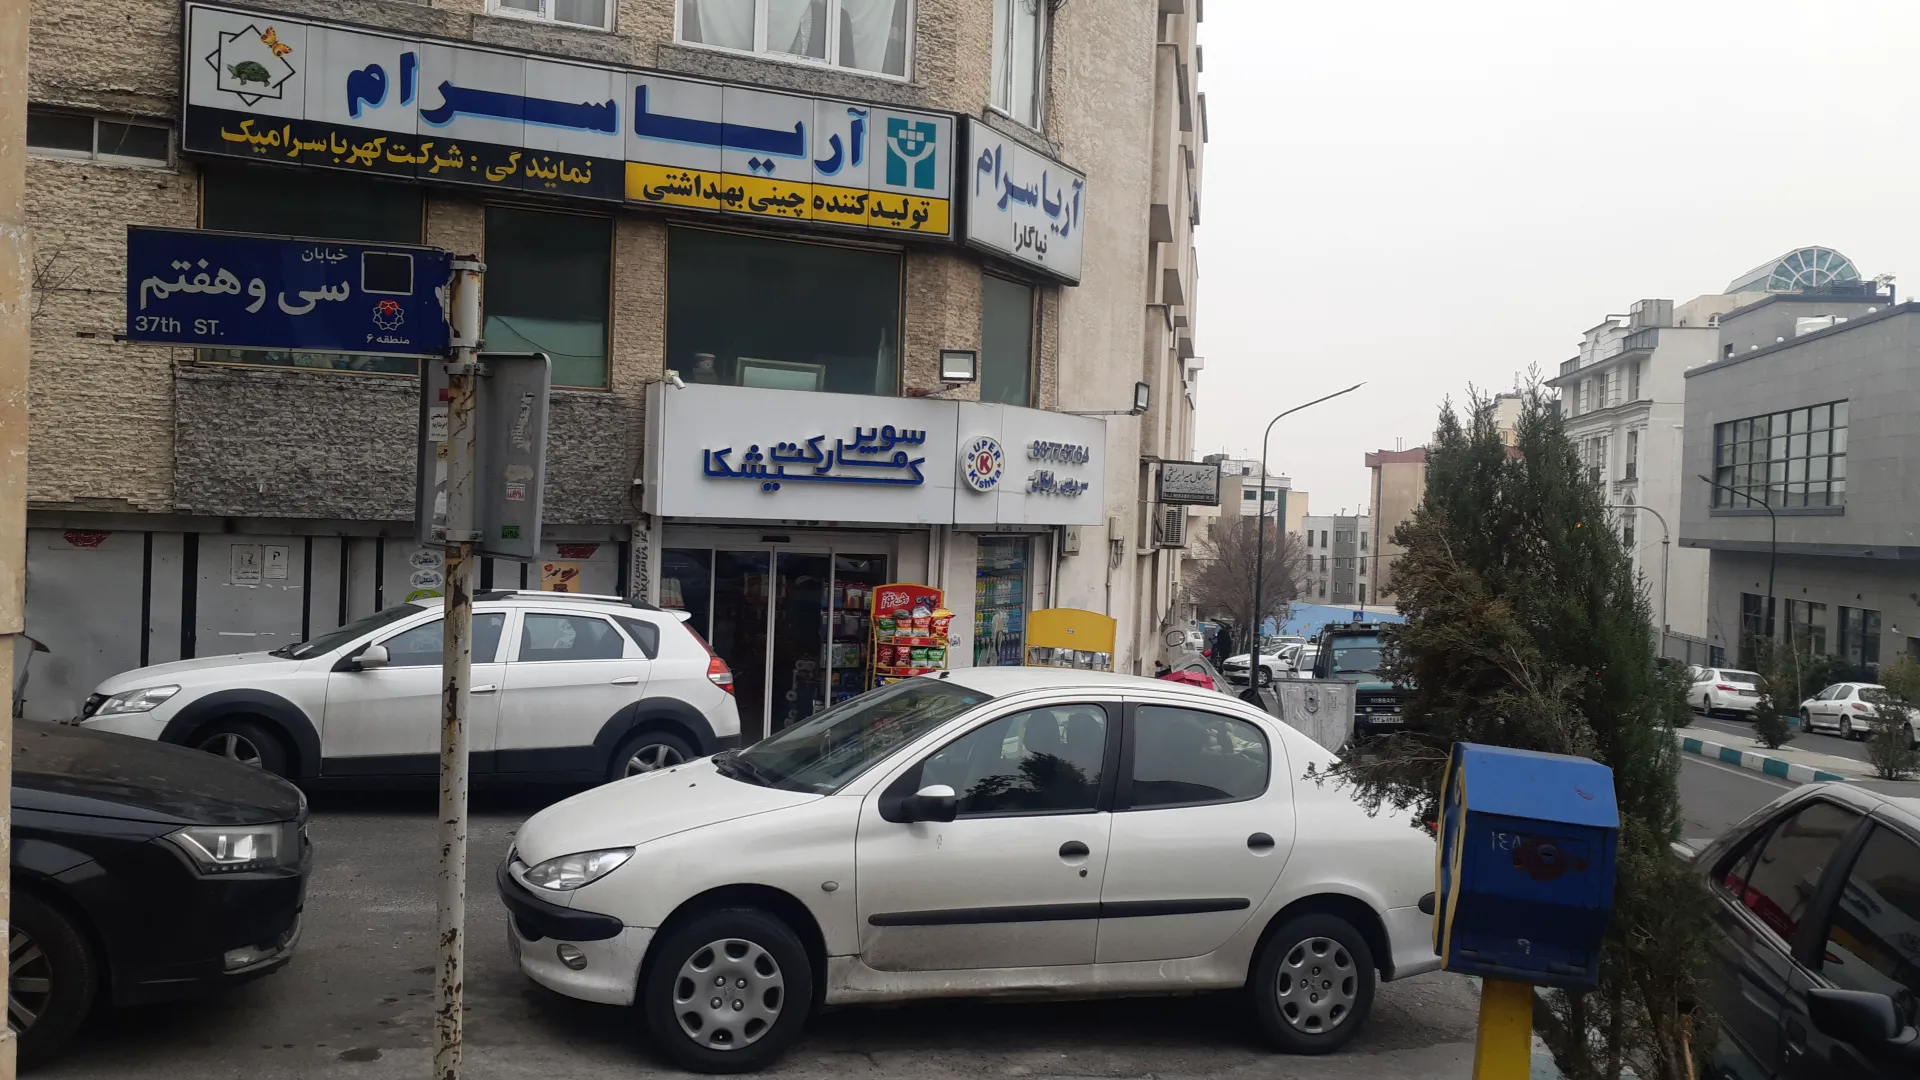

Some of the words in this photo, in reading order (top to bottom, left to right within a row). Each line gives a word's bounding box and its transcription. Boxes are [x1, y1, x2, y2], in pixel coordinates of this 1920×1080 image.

[346, 51, 619, 134] سرام
[634, 84, 869, 176] آریا
[386, 141, 464, 174] شرکت
[486, 151, 592, 189] نمایندگی
[643, 172, 745, 210] بهداشتی
[976, 143, 1038, 211] سرام
[748, 186, 805, 217] چینی
[1042, 169, 1084, 238] آریا
[301, 246, 349, 265] خیابان
[1013, 221, 1047, 260] نیاگارا
[140, 258, 241, 311] هفتم
[245, 277, 266, 313] و
[278, 280, 350, 315] سی
[135, 315, 181, 334] 37th
[194, 318, 225, 336] ST.
[376, 335, 410, 345] منطقه
[770, 435, 908, 474] مارکت
[845, 424, 926, 454] سوپر
[968, 440, 1001, 462] SUPER
[703, 444, 925, 492] کیشکا
[968, 469, 1001, 489] Kishka
[980, 454, 992, 474] K
[1190, 470, 1205, 484] جمال
[1200, 468, 1215, 482] دکتر
